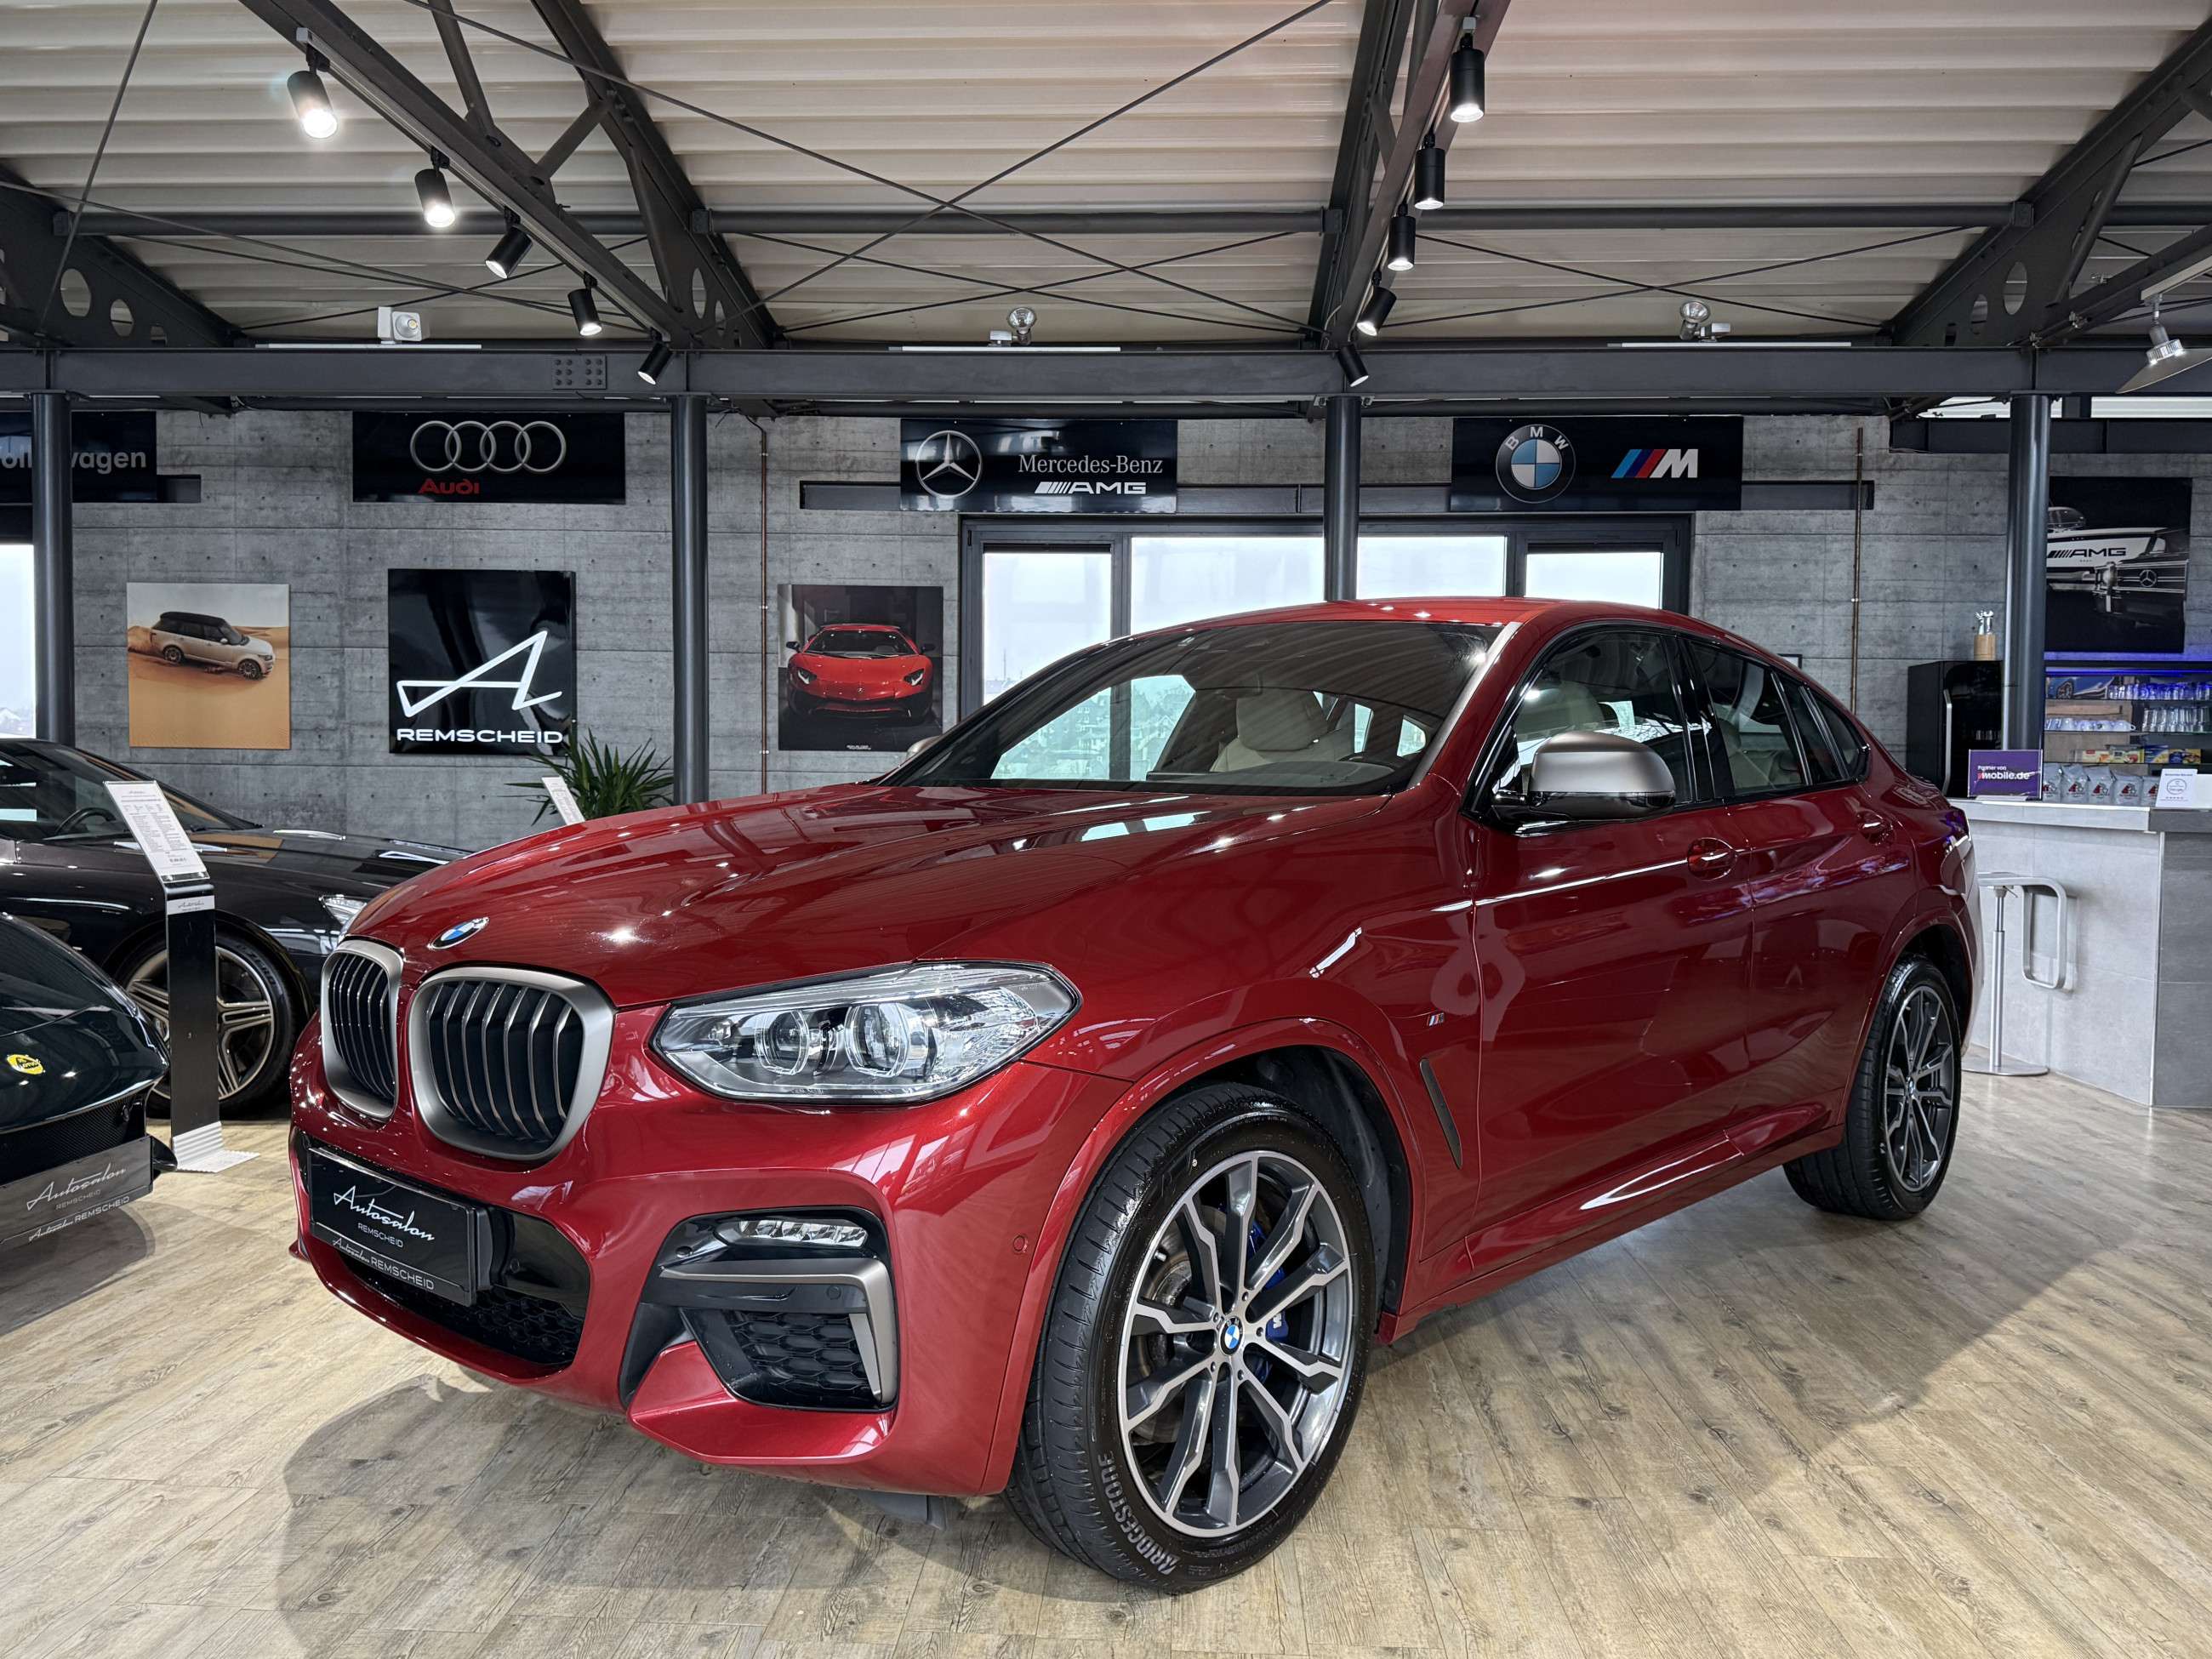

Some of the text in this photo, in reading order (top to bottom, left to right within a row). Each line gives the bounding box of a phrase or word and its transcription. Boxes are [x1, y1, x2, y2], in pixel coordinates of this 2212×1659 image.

[1505, 426, 1569, 450] BMW
[1018, 454, 1163, 474] Mercedes-Benz
[418, 478, 480, 494] Audi
[1068, 482, 1147, 494] AMG
[2069, 547, 2127, 558] AMG
[396, 728, 563, 744] REMSCHEID
[26, 1162, 127, 1211] Autosalon
[55, 1189, 101, 1210] REMSCHEID
[74, 1196, 130, 1223] REMSCHEID
[334, 1185, 436, 1241] Autosalon
[357, 1223, 403, 1248] REMSCHEID
[370, 1256, 435, 1291] REMSCHEID
[1097, 1451, 1181, 1575] BRIDGESTONE
